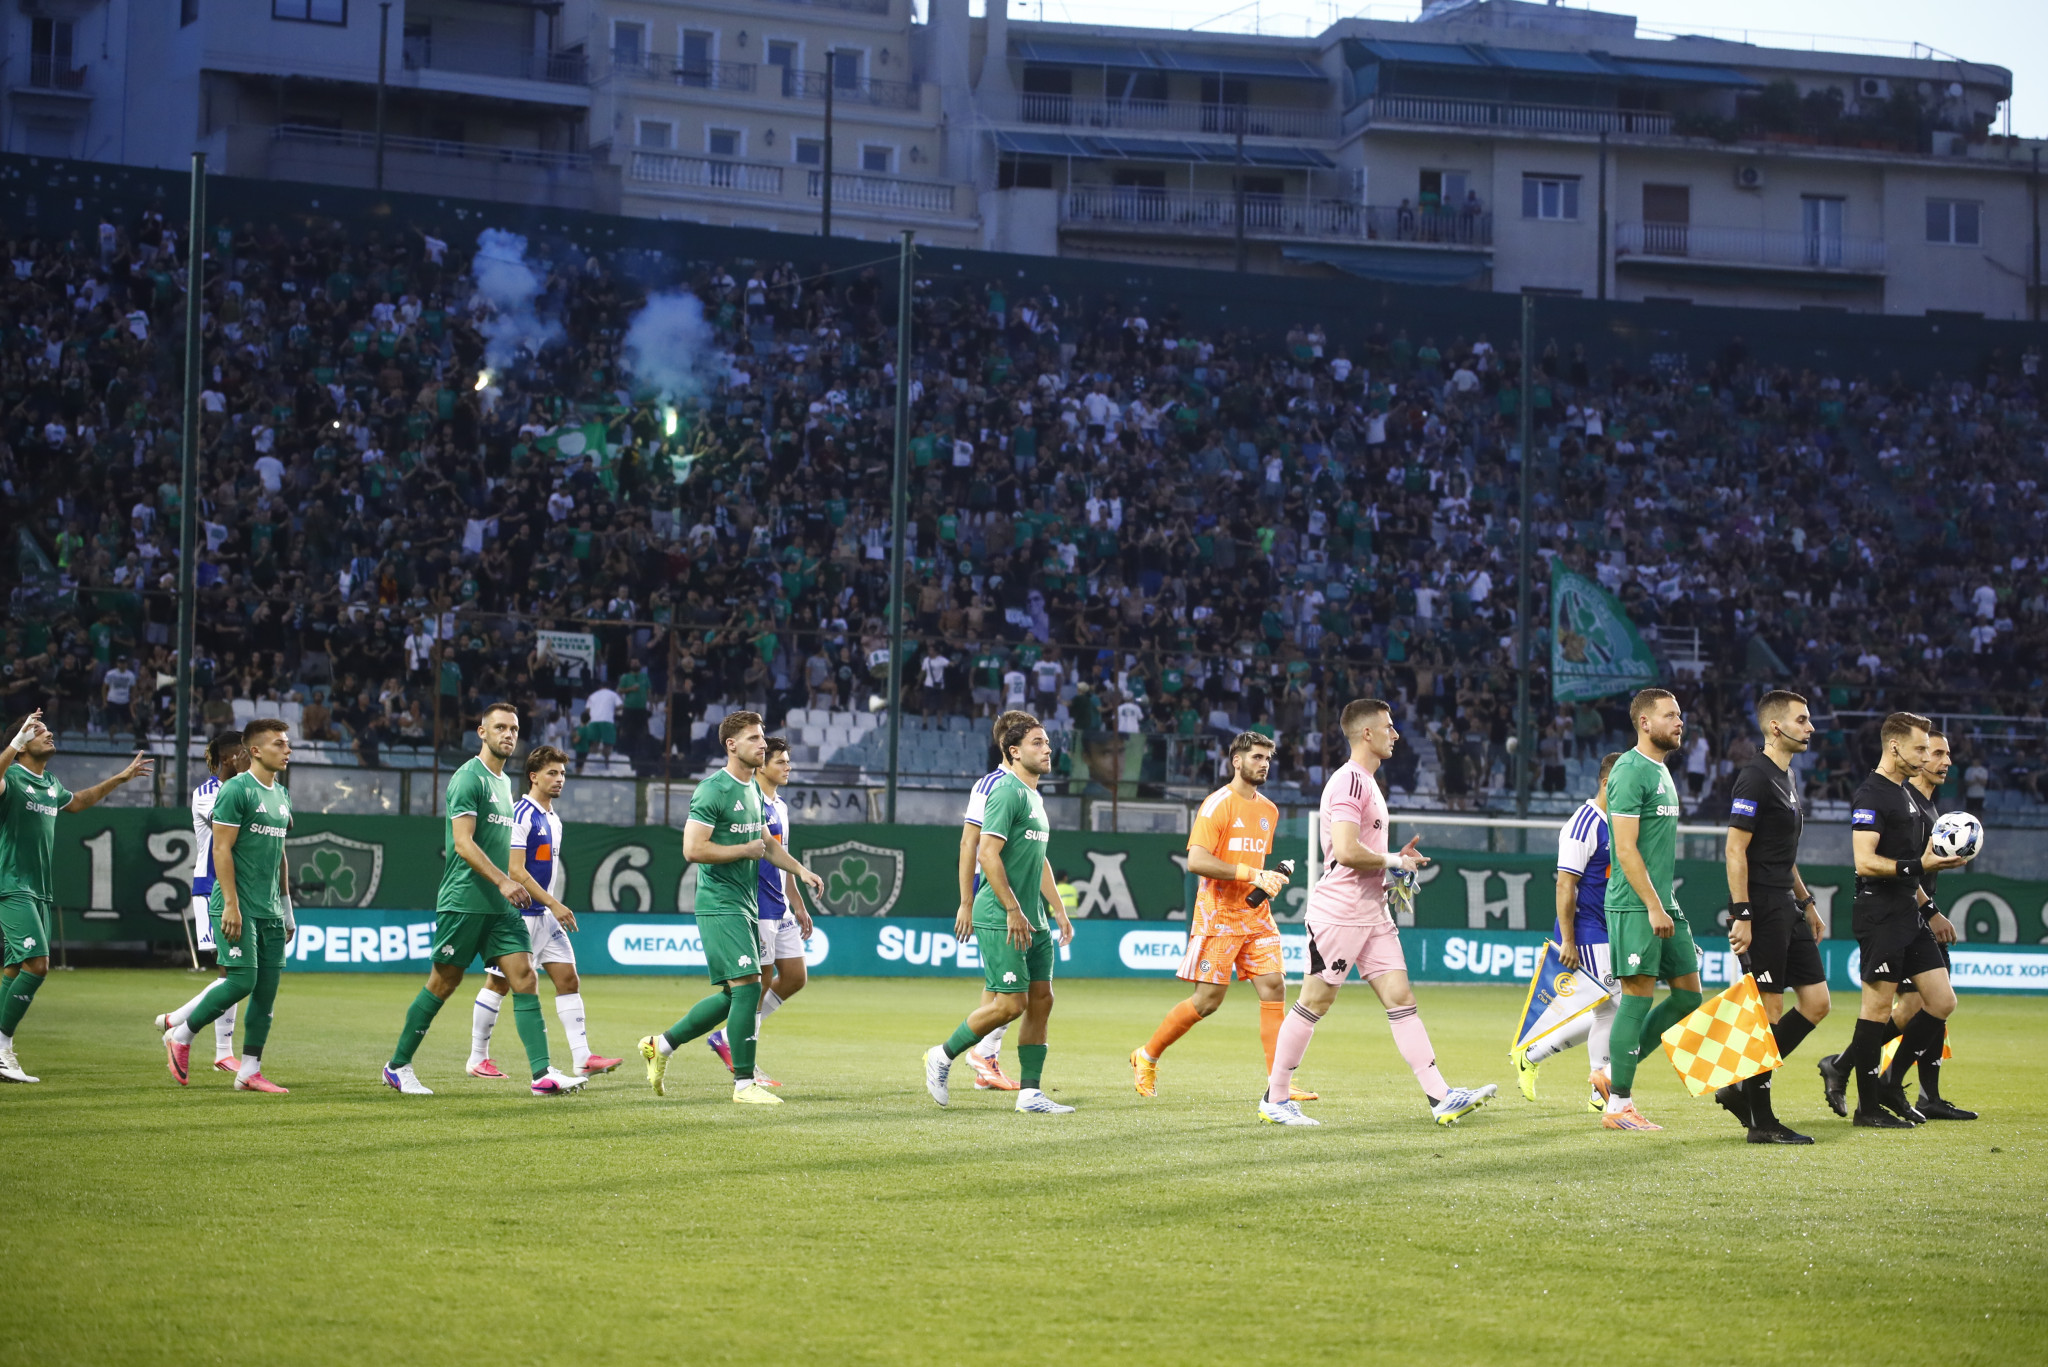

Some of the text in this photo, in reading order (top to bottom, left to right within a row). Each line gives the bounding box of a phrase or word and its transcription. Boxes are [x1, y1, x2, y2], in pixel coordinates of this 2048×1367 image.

[285, 921, 437, 963] PERBE
[876, 925, 1075, 969] SUPET
[1133, 943, 1187, 957] ΜΕΓΑ
[1949, 962, 2014, 977] ΕΓΑΛΟΣ
